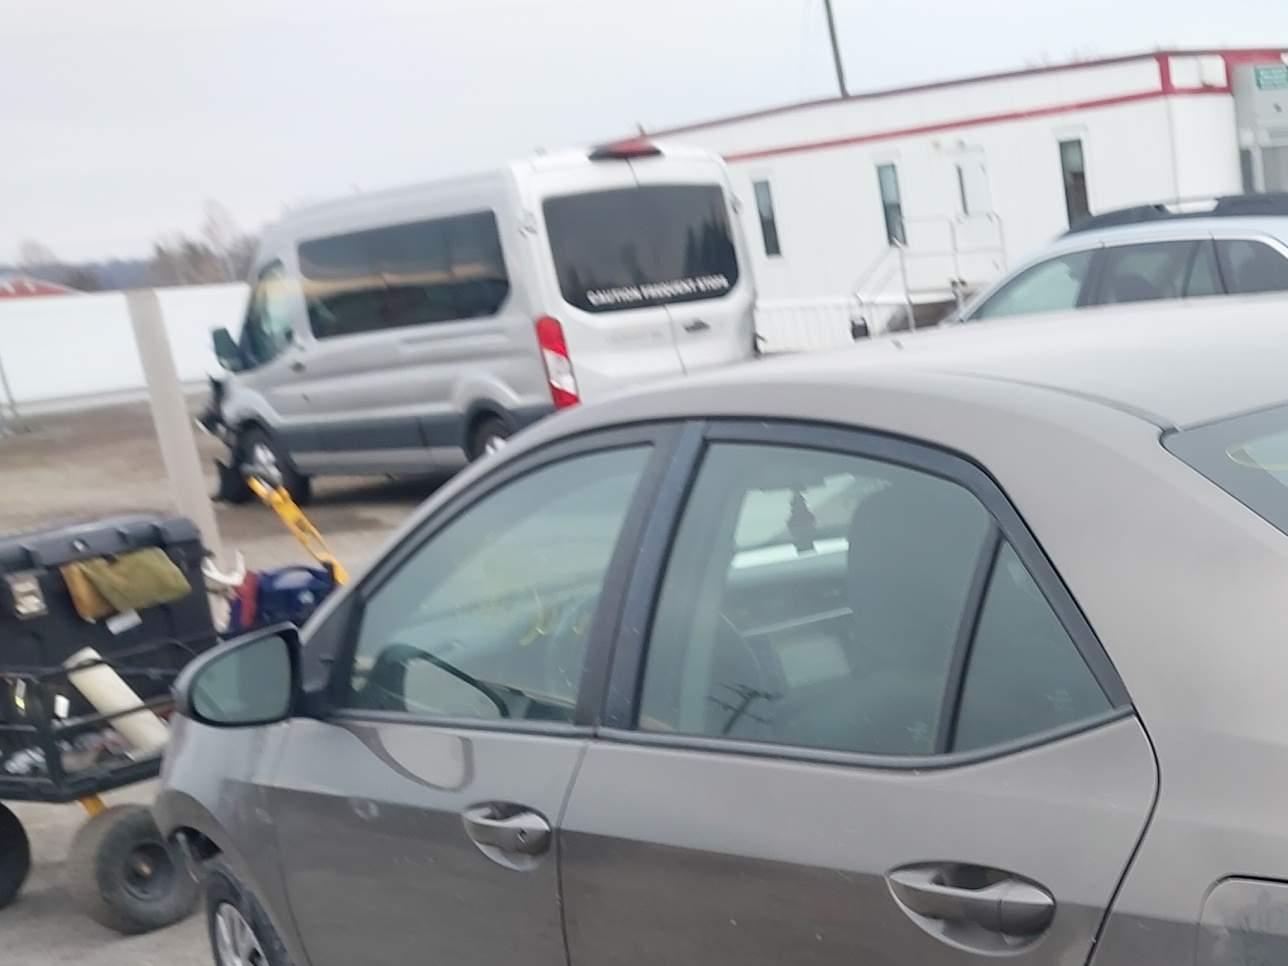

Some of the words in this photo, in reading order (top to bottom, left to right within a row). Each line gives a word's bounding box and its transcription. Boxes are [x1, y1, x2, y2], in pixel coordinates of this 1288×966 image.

[586, 285, 642, 306] CAUTION
[639, 277, 697, 300] FREQUENT
[695, 273, 729, 292] STOPS
